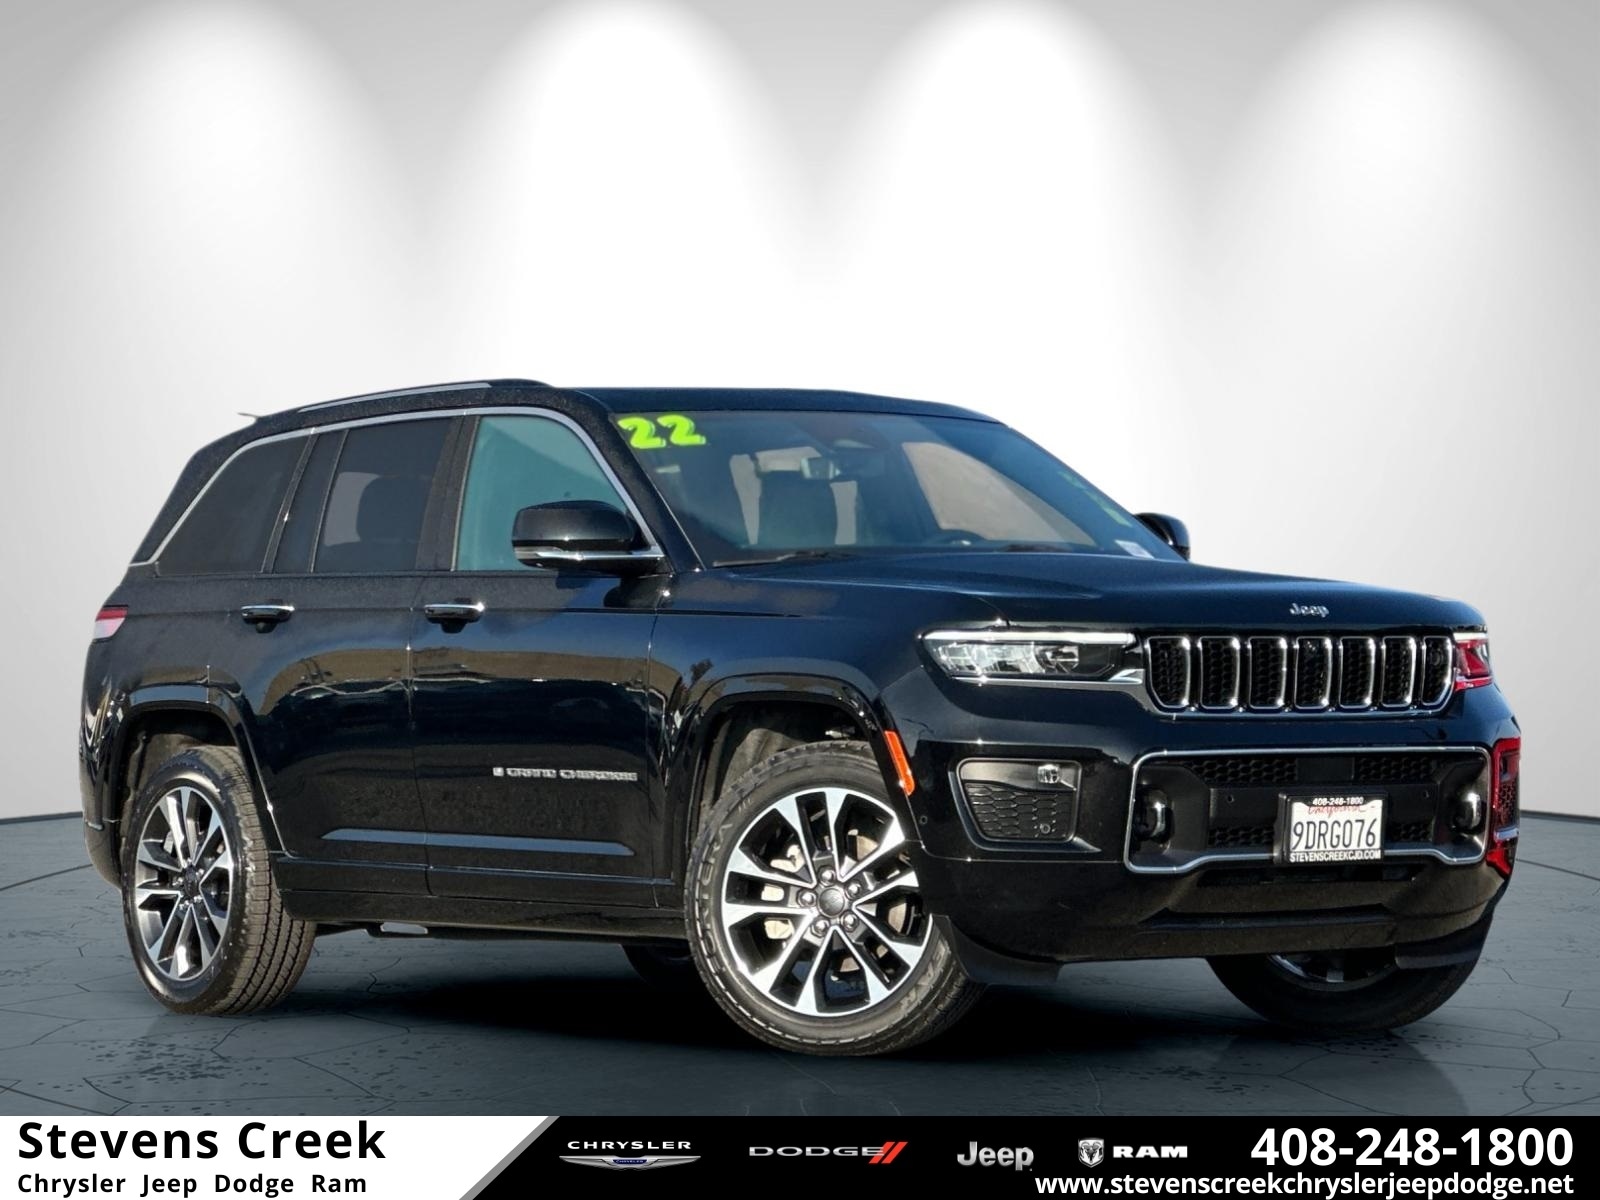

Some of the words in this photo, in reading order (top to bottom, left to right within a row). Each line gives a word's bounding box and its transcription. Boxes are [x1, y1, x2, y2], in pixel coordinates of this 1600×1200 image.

[617, 414, 706, 449] 22
[1289, 602, 1330, 618] Jeep
[1292, 819, 1377, 849] 9DRG076
[1290, 850, 1381, 862] STEVENSCREEKCJD.COM
